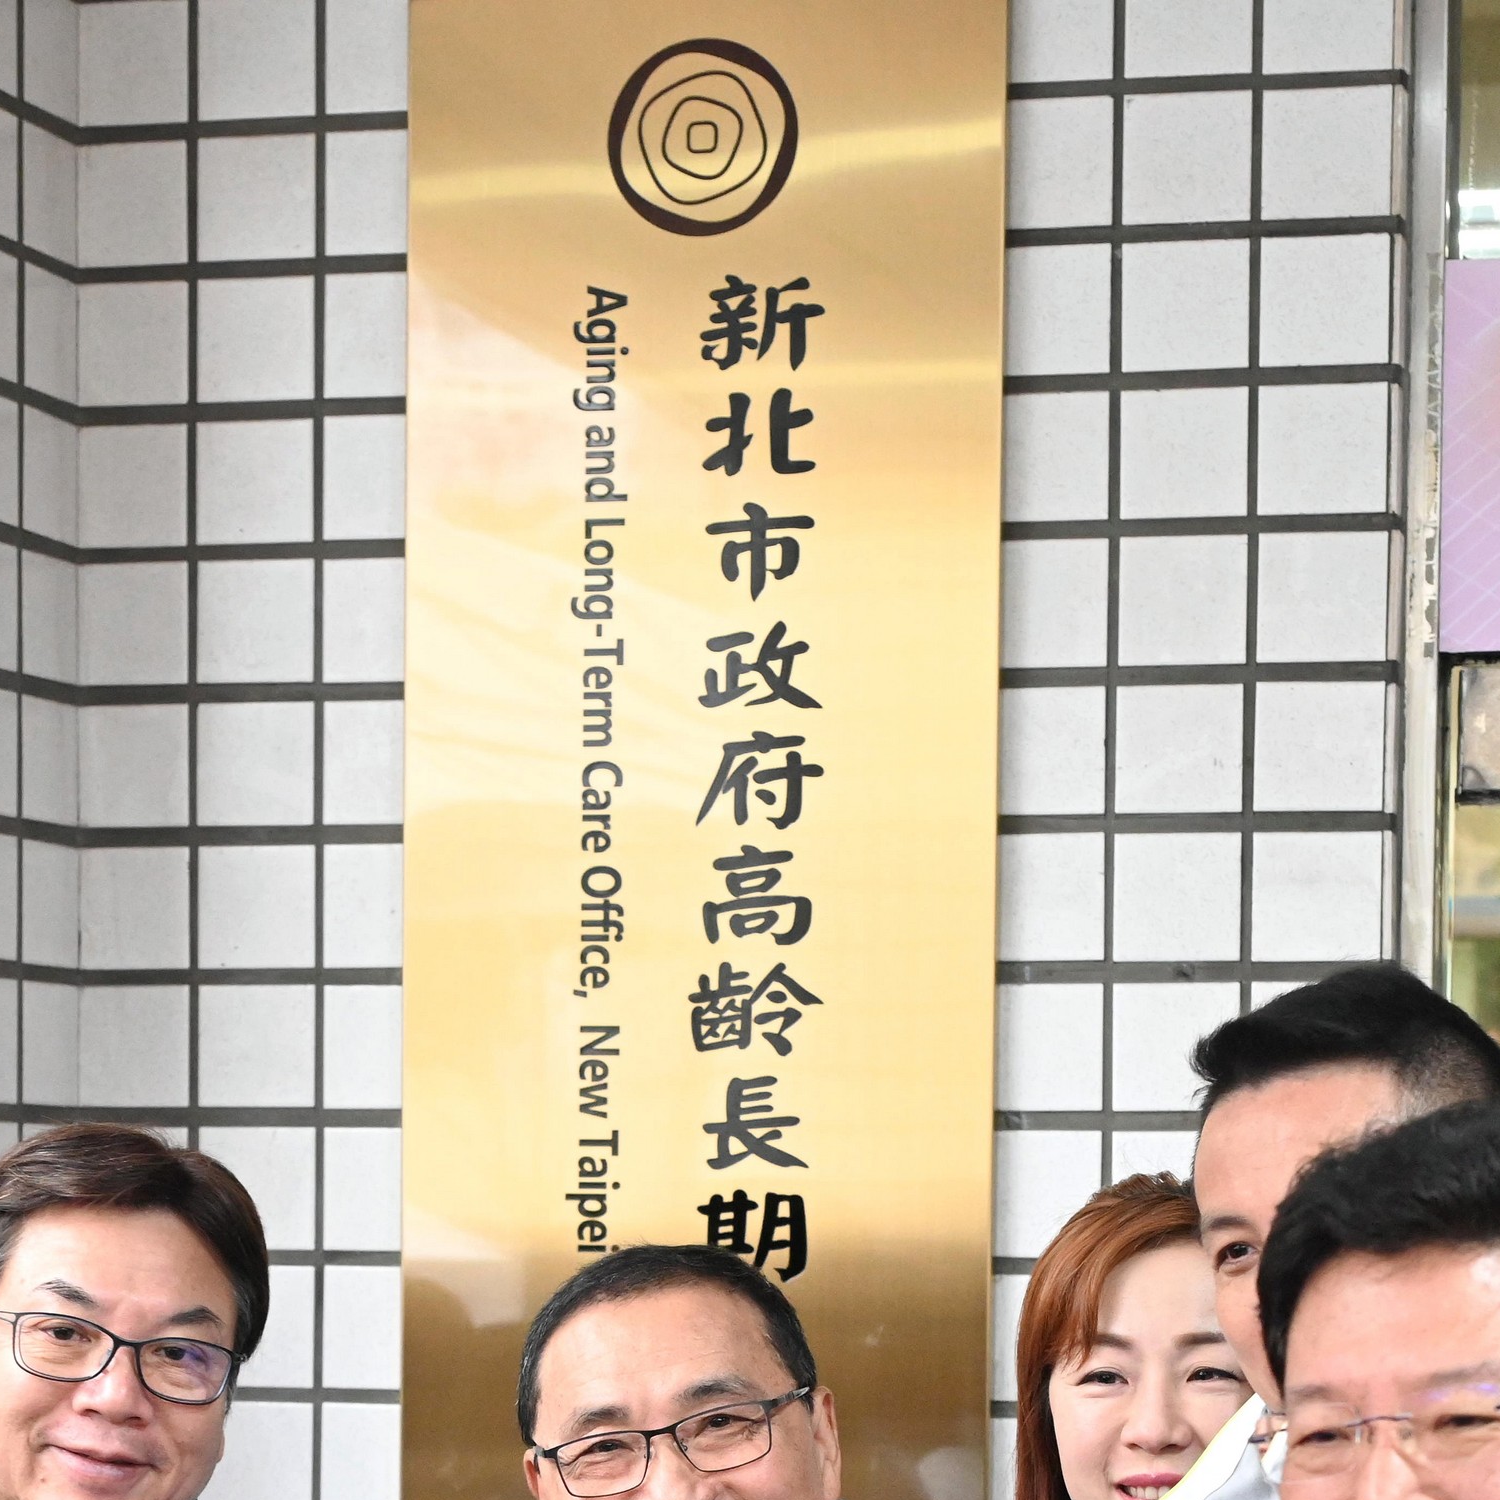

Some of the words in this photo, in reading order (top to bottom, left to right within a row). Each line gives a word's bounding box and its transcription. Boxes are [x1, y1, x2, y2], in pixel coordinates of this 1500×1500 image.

[573, 284, 630, 412] Aging
[584, 424, 628, 503] and
[570, 517, 626, 748] Long-Term
[580, 759, 624, 854] Care
[687, 273, 826, 1284] 新北市政府高齡長期
[572, 864, 625, 999] Office,
[577, 1024, 621, 1119] New
[565, 1129, 621, 1253] Taipei
